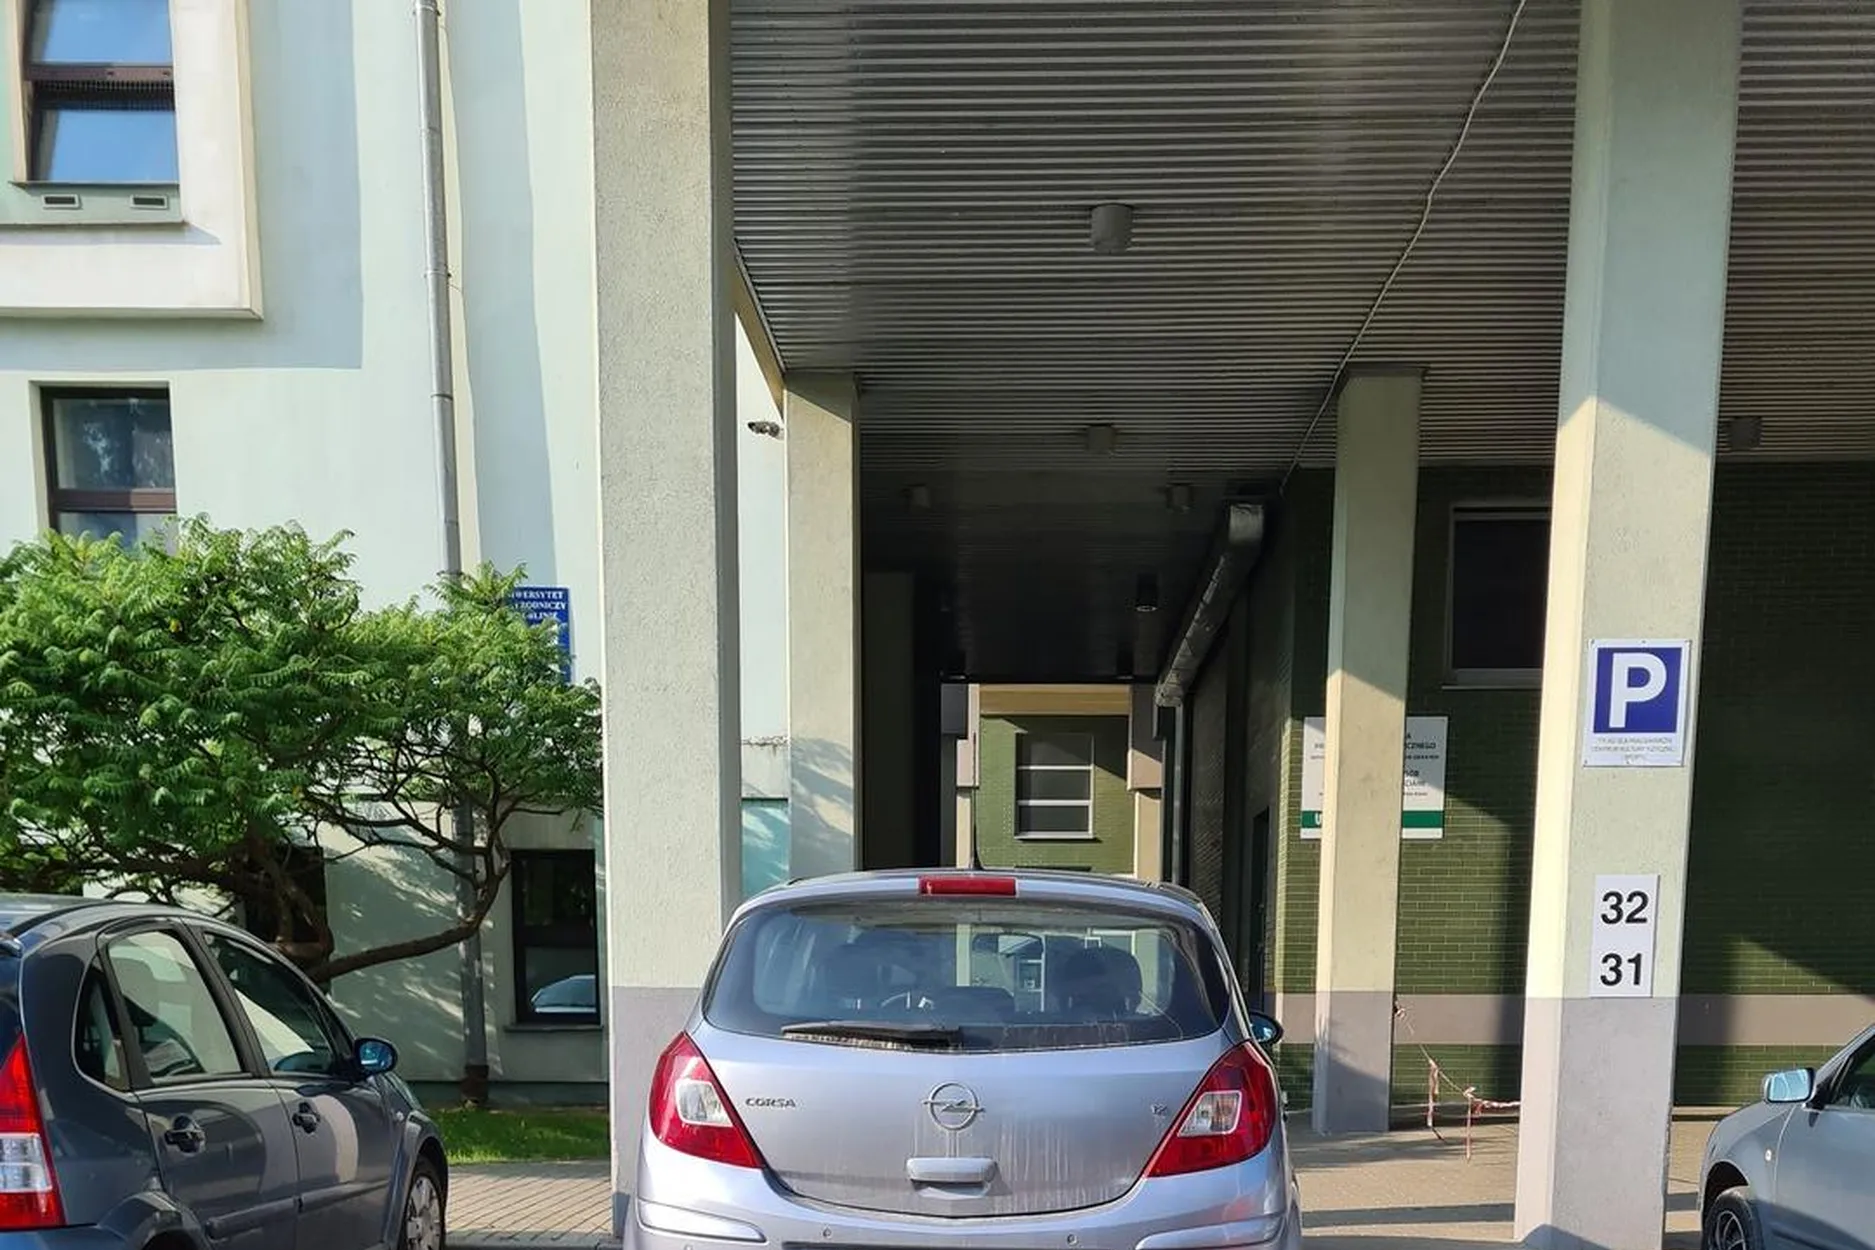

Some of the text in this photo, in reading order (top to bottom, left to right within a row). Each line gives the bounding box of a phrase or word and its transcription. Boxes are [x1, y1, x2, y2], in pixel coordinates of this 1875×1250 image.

[1609, 652, 1667, 728] P
[1601, 890, 1649, 924] 32
[1600, 953, 1642, 986] 31
[745, 1098, 796, 1108] CORSA
